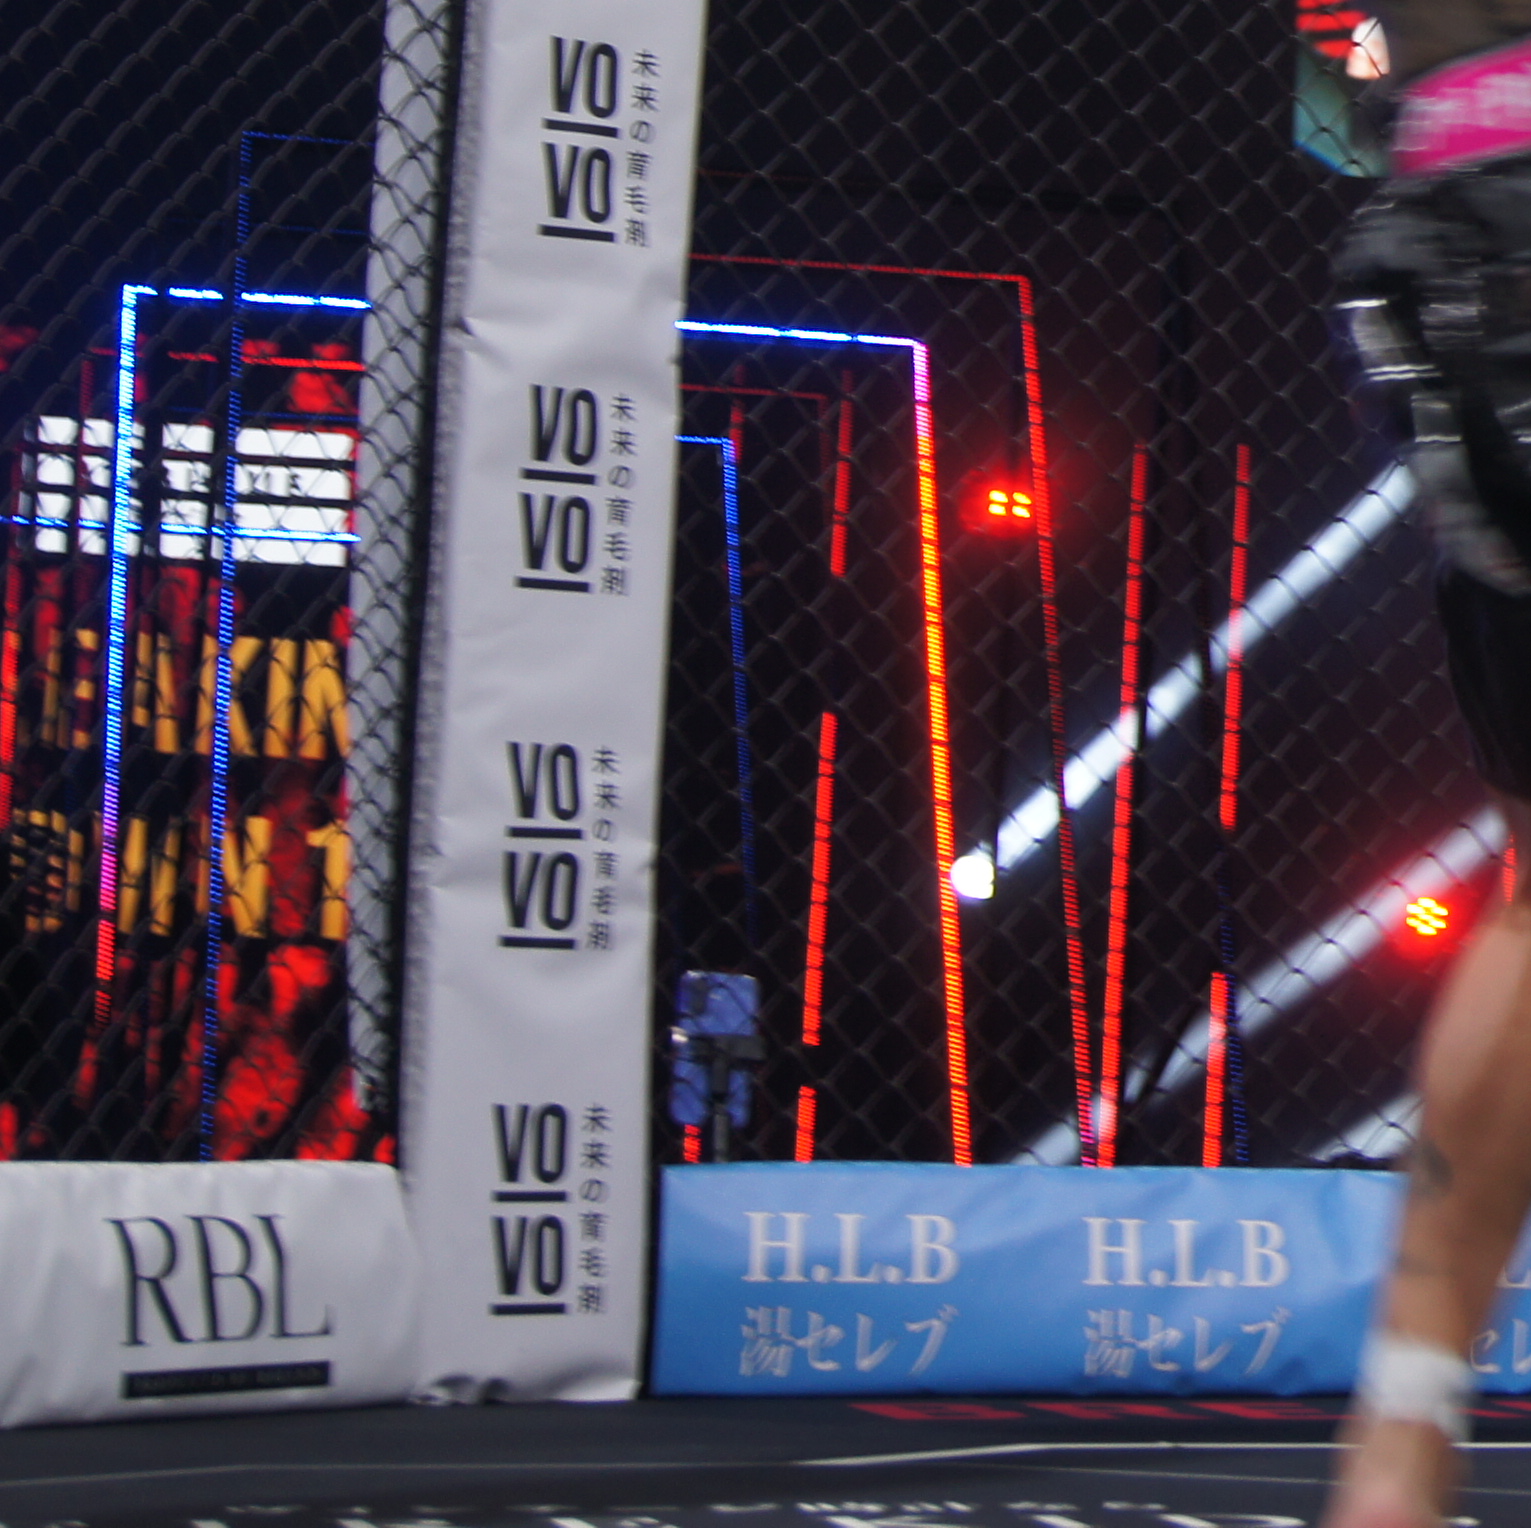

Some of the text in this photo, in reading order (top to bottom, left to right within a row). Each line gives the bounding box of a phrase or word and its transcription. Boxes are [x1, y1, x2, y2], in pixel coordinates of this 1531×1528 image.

[103, 1213, 334, 1347] RBL
[742, 1211, 960, 1284] H.L.B
[1081, 1217, 1291, 1288] H.L.B
